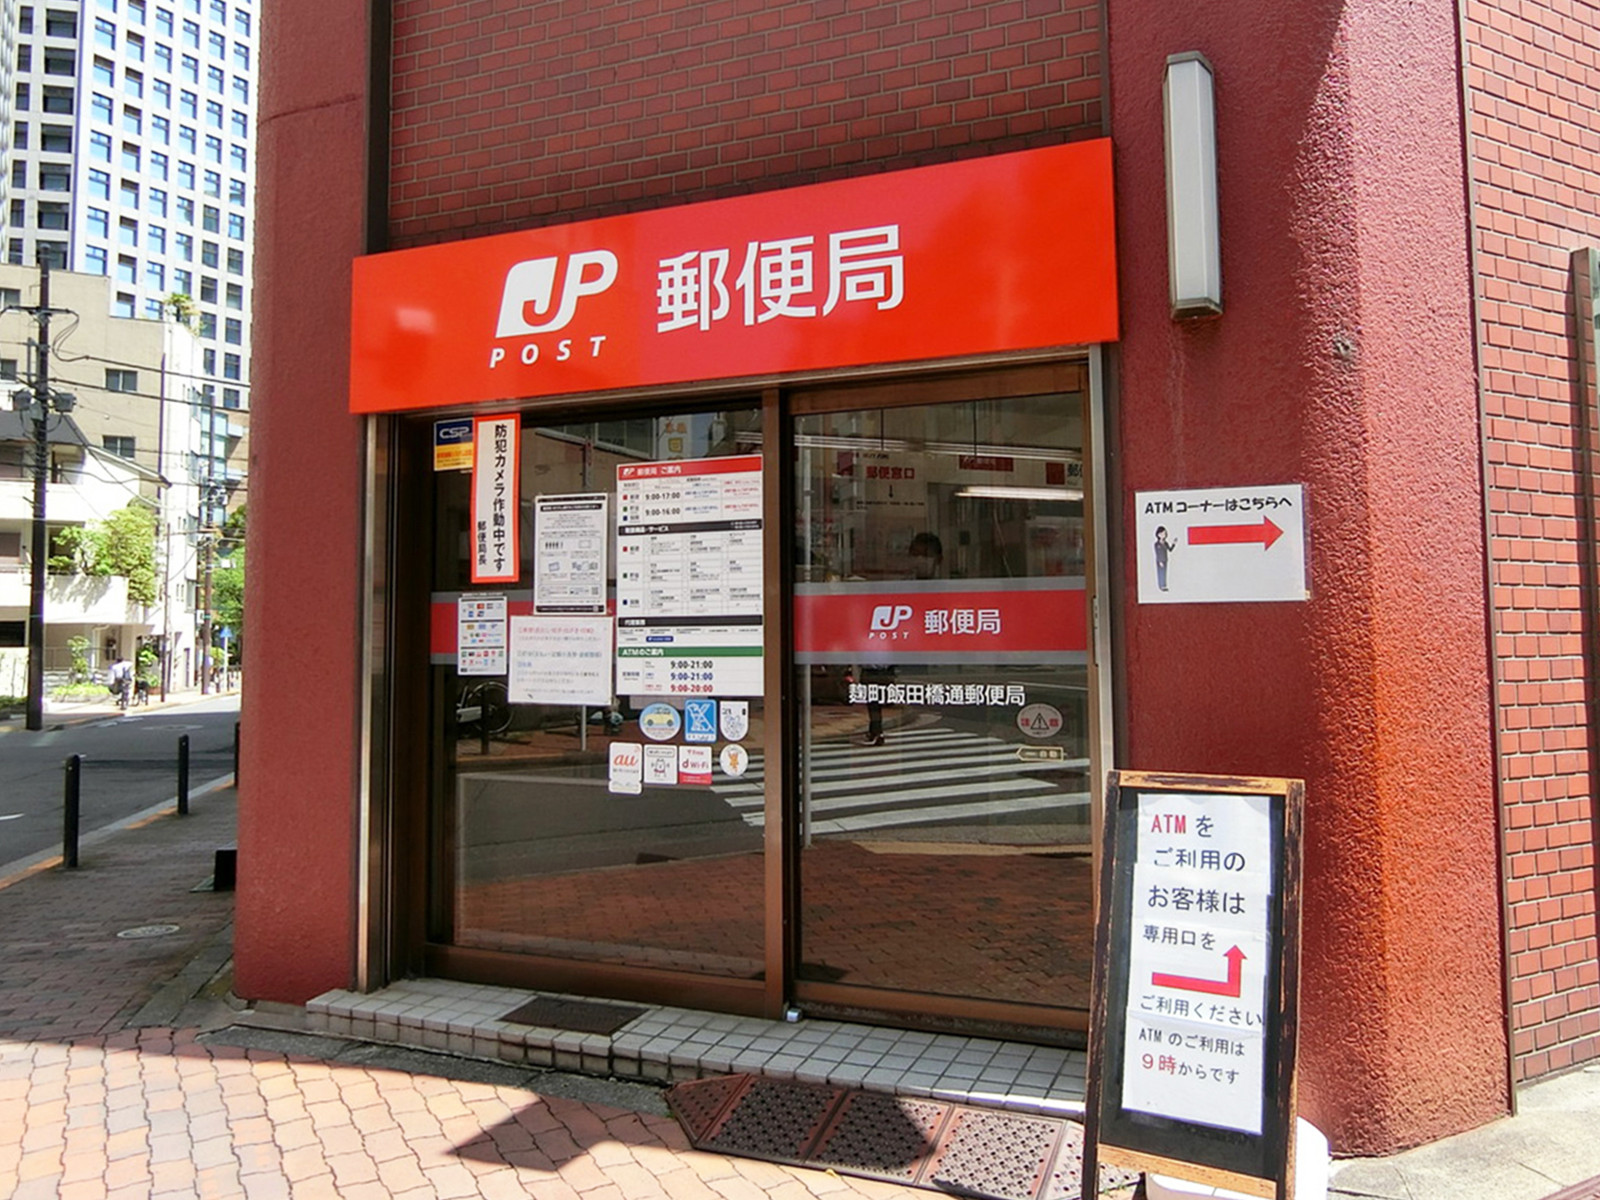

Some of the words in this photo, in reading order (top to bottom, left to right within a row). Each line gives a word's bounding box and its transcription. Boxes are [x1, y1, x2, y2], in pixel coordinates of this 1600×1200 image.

[656, 224, 905, 334] 郵便局
[489, 335, 607, 369] POST
[439, 425, 470, 440] CSP
[492, 424, 508, 572] 防犯カメラ作動中です
[645, 492, 681, 501] 9:00-17:00
[645, 507, 681, 516] 9:00-16:00
[477, 521, 487, 566] 郵便局長
[924, 608, 1001, 635] 郵便局
[868, 631, 910, 640] POST
[670, 660, 713, 669] 9:00-21:00
[670, 672, 713, 681] 9:00-21:00
[670, 684, 713, 693] 9:00-20:00
[848, 683, 1026, 706] 麹町飯田橋通郵便局
[613, 753, 639, 767] au
[1151, 814, 1187, 834] ATM
[1195, 815, 1214, 838] を
[1154, 847, 1246, 872] ご利用の
[1148, 884, 1246, 915] お客様は
[1142, 924, 1216, 951] 専用口を
[1140, 994, 1265, 1027] ご利用ください
[1138, 1028, 1163, 1043] ATM
[1168, 1032, 1246, 1057] のご利用は
